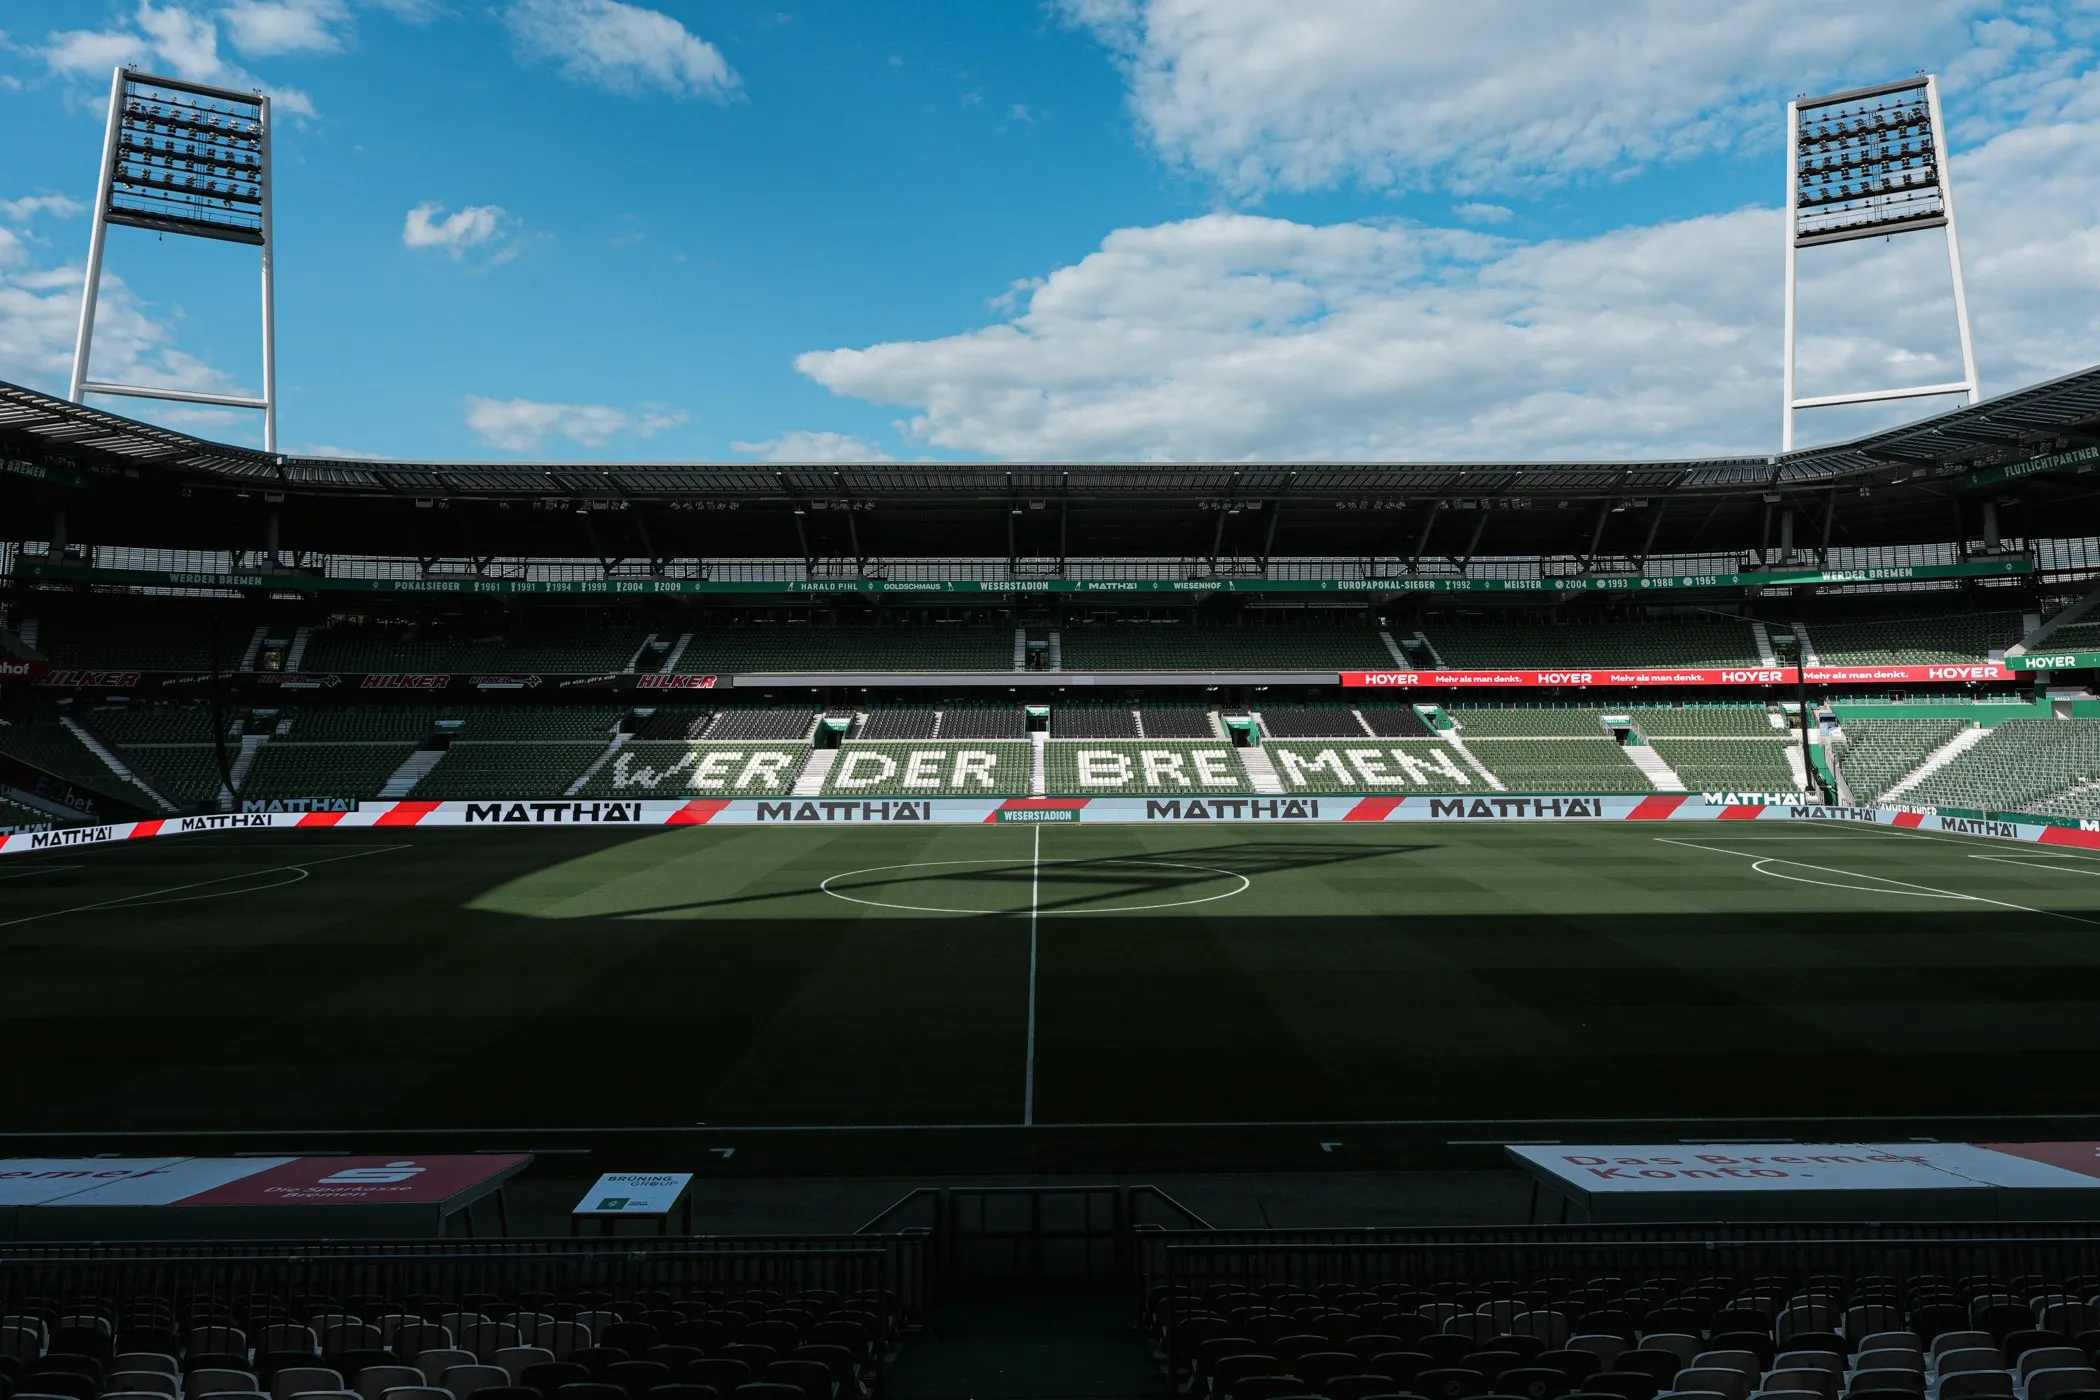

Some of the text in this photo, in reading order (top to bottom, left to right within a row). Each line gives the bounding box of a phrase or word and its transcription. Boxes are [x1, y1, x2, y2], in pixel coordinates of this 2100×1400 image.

[2004, 446, 2100, 477] FLUTLICHTPARTNER
[169, 573, 262, 586] WERDER BREMEN
[1822, 567, 1913, 581] WERDER BREMEN
[395, 580, 681, 592] POKALSIEGER 1961 1991 1994 1999 2004 2009
[801, 582, 858, 591] HARALD PIHL
[884, 582, 941, 591] GOLDSCHMAUS
[980, 581, 1049, 591] WESERSTADION
[1089, 581, 1137, 590] MATTHÄI
[1174, 581, 1222, 590] WIESENHOF
[1338, 580, 1471, 590] EUROPAPOKAL-SIEGER 1992
[1504, 576, 1716, 590] MEISTER 2004 1993 1988 1965
[2025, 655, 2076, 668] HOYER
[1365, 674, 1418, 685] HOYER
[1435, 675, 1458, 683] Mehr
[1459, 675, 1472, 683] als
[1494, 675, 1523, 683] denkt.
[1537, 673, 1592, 684] HOYER
[1611, 674, 1635, 682] Mehr
[1636, 674, 1650, 682] als
[1673, 674, 1705, 682] denkt.
[1722, 671, 1783, 682] HOYER
[1803, 670, 1909, 680] Mehr als man denkt.
[1928, 667, 1999, 679] HOYER
[360, 674, 452, 689] HILKER
[636, 674, 718, 689] HILKER
[242, 798, 356, 812] MATTHÄI
[1702, 792, 1805, 806] MATTHÄI
[466, 803, 641, 822] MATTHÄI
[757, 801, 930, 821] MATTHÄI
[1147, 799, 1319, 819] MATTHÄI
[1430, 797, 1602, 817] MATTHÄI
[1004, 810, 1073, 822] WESERSTADION
[1790, 806, 1876, 822] MATTHÄI
[182, 814, 272, 831] MATTHÄI
[1941, 817, 2018, 838] MATTHÄI
[32, 825, 112, 848] MATTHÄI
[1561, 1153, 1931, 1166] Das Bremer
[1587, 1167, 1815, 1180] Konto.
[303, 1185, 412, 1193] Sparkasse
